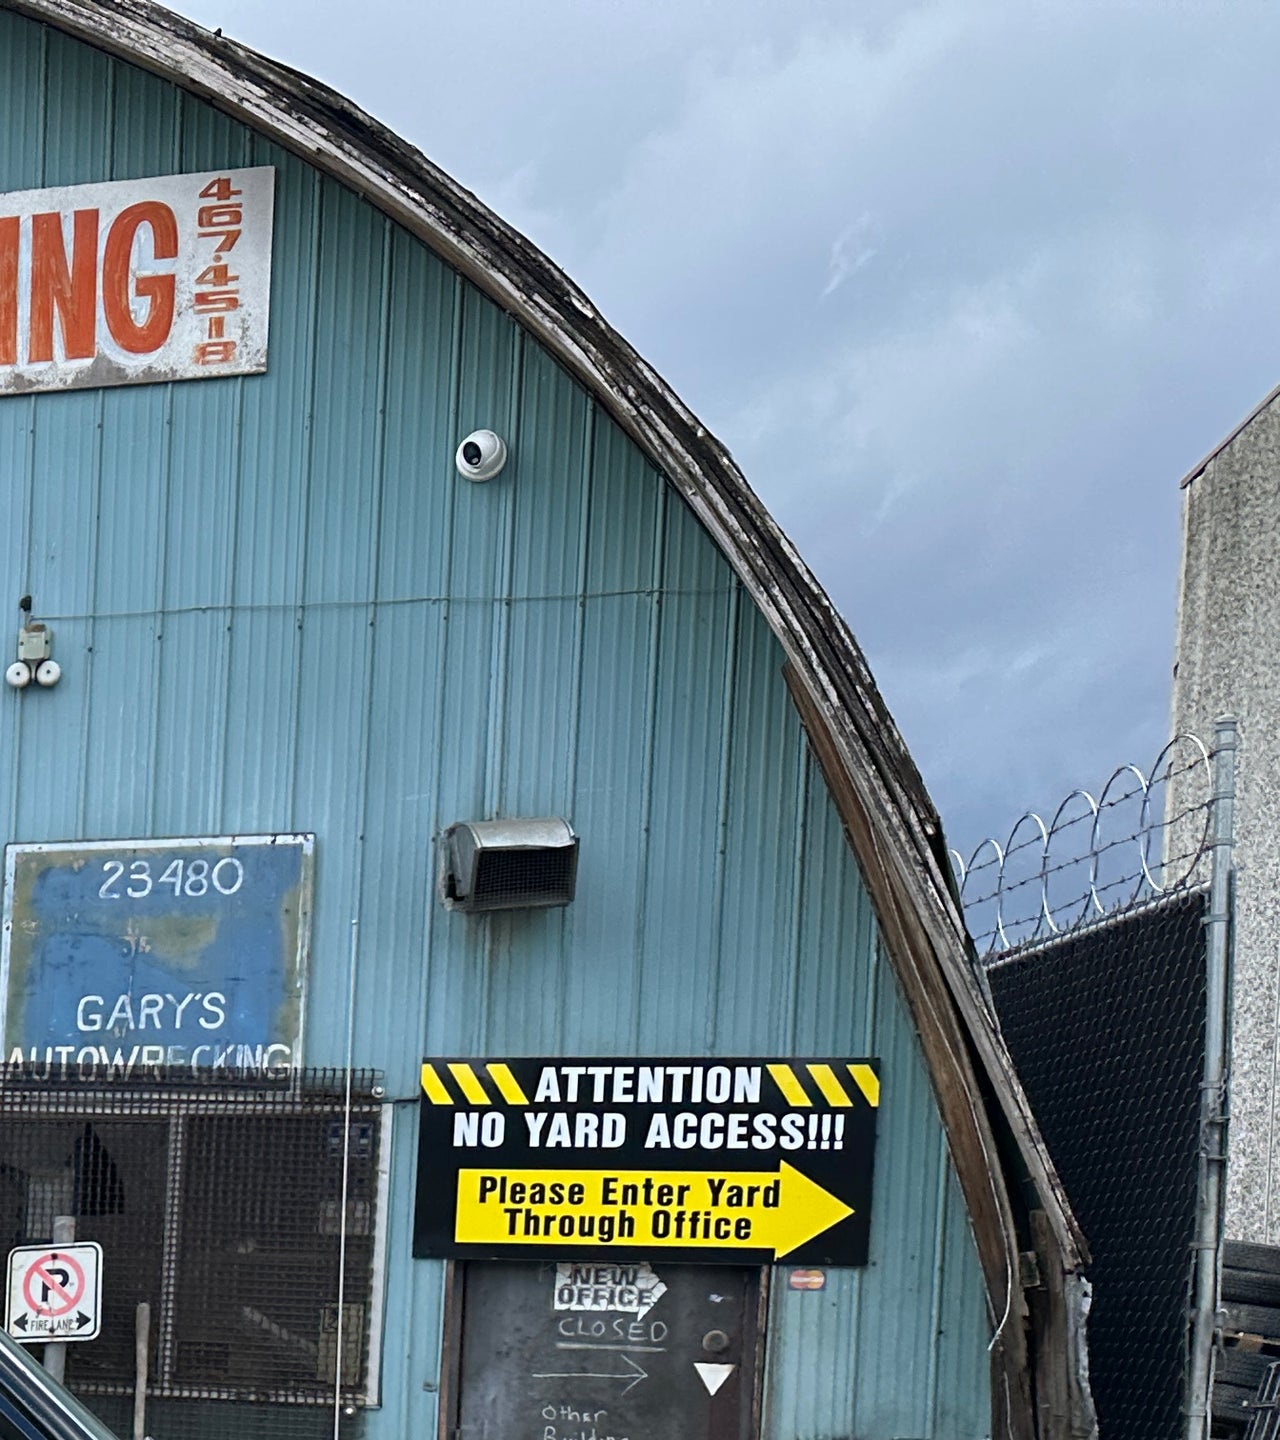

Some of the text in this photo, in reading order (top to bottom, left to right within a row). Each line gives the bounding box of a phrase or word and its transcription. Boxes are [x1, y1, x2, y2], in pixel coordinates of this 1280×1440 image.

[98, 857, 245, 899] 23480
[75, 991, 227, 1032] GARY'S
[534, 1065, 762, 1104] ATTENTION
[453, 1111, 845, 1151] NO YARD ACCESS!!!
[478, 1175, 781, 1209] Please Enter Yard
[503, 1208, 752, 1242] Through Office
[572, 1267, 638, 1286] NEW
[558, 1285, 653, 1306] OFFICE
[30, 1319, 50, 1331] FIRE
[558, 1317, 668, 1342] CLOSED
[541, 1404, 608, 1422] Other
